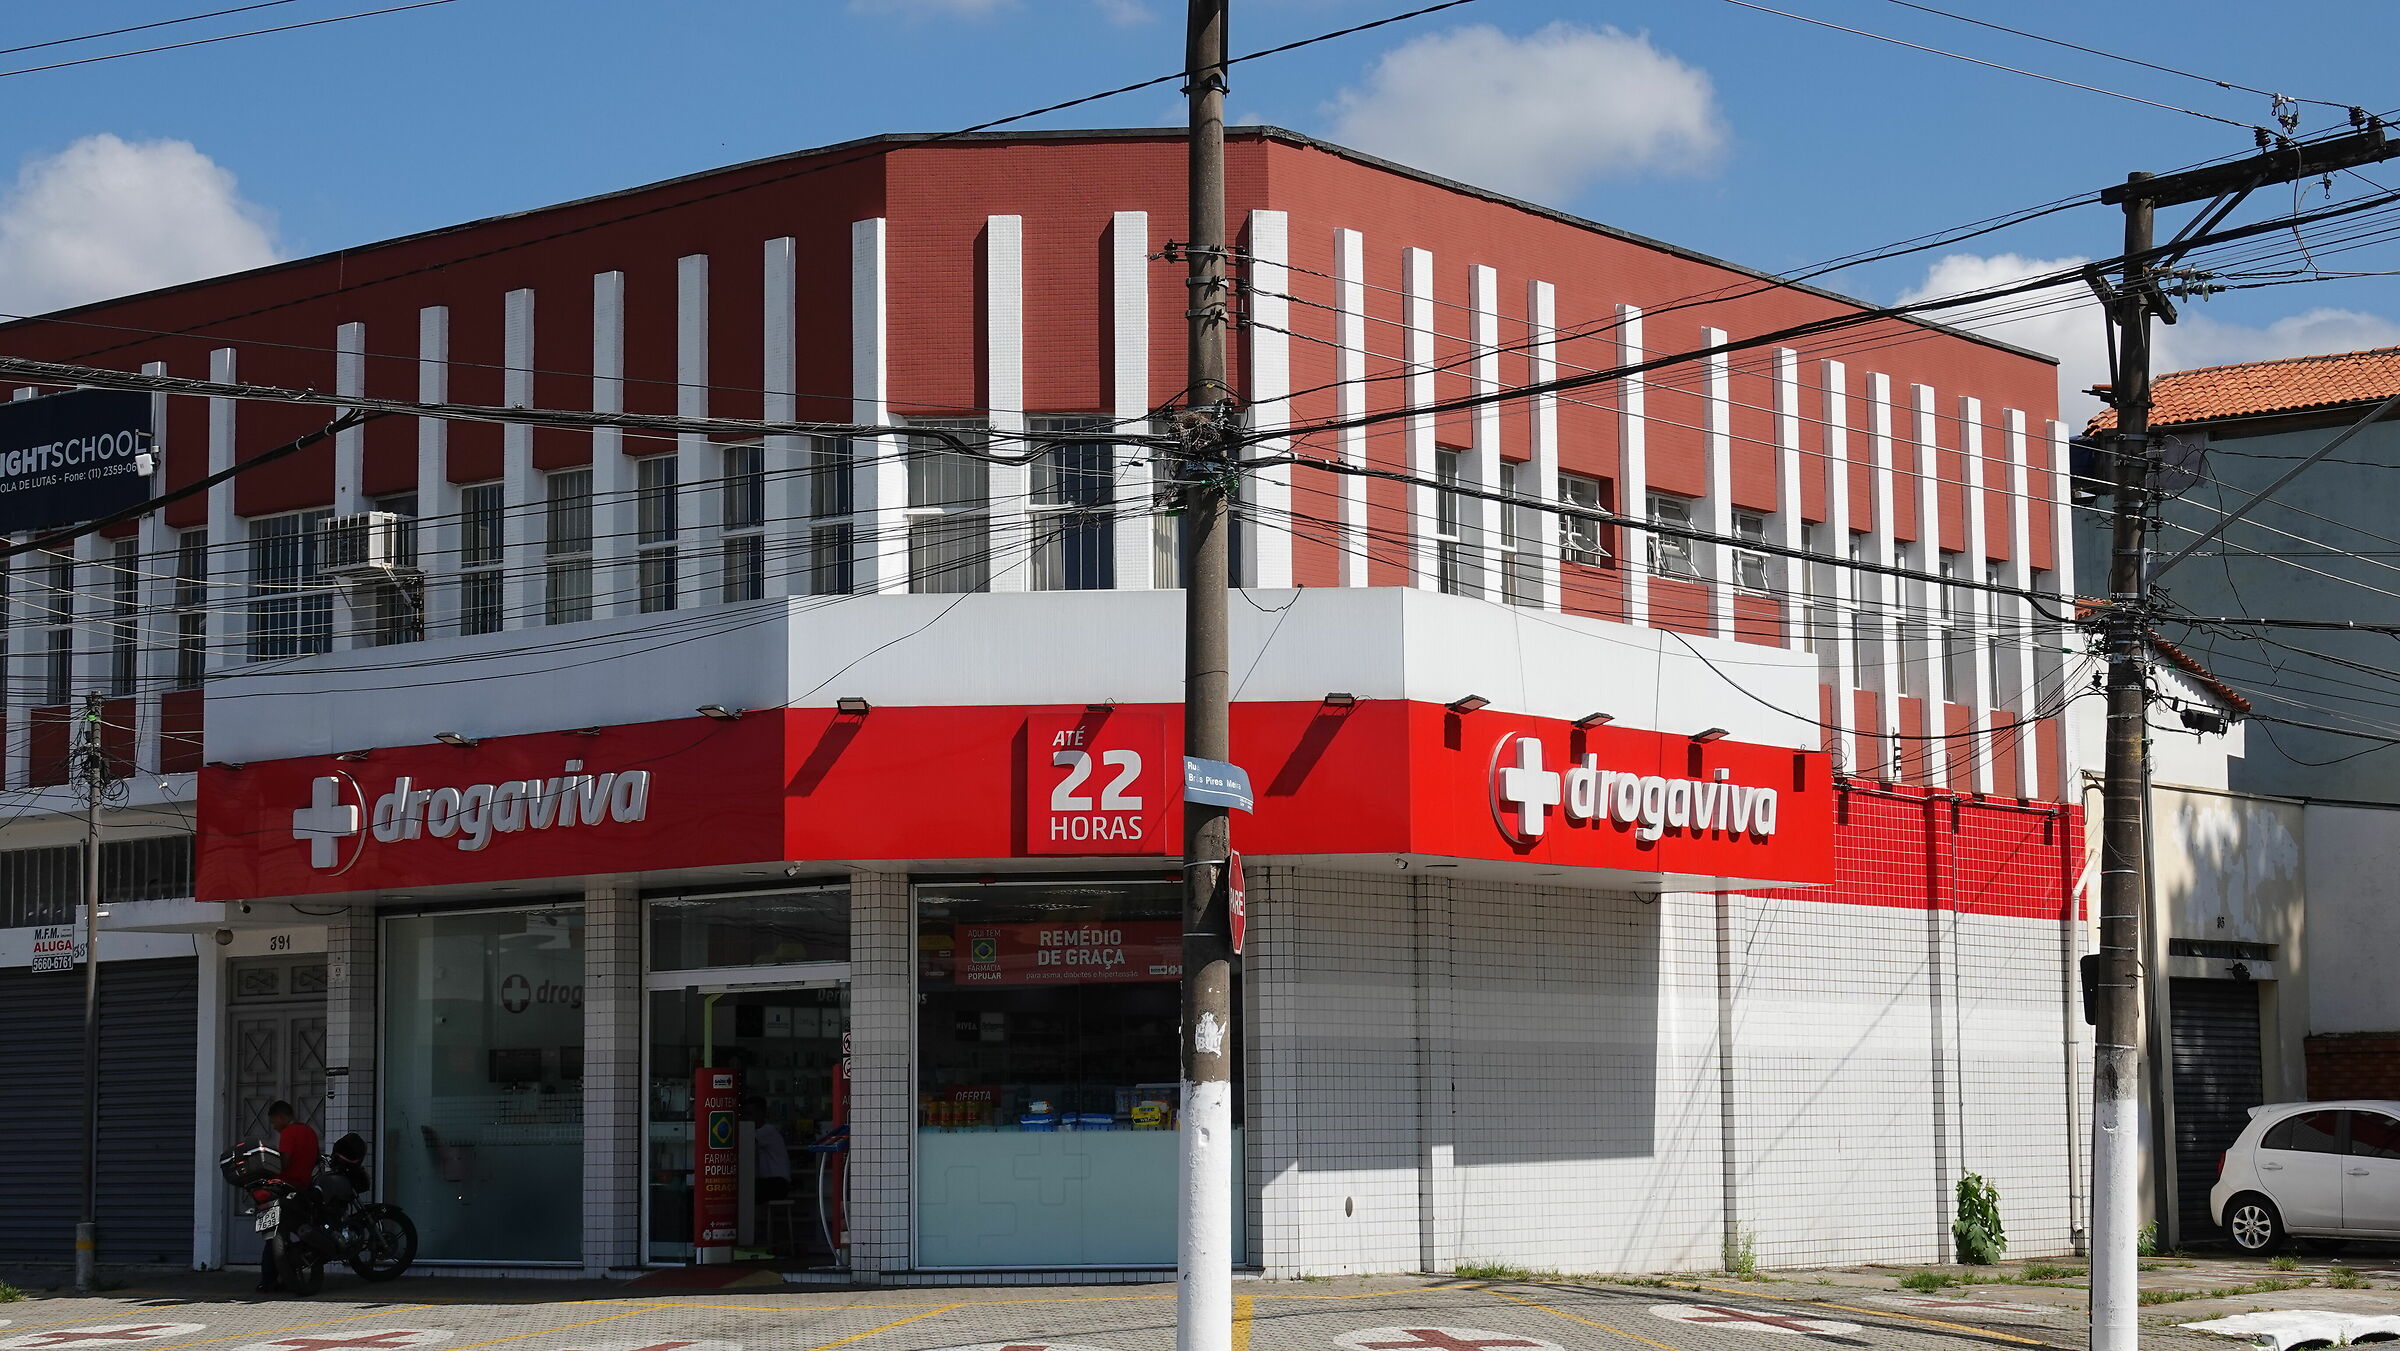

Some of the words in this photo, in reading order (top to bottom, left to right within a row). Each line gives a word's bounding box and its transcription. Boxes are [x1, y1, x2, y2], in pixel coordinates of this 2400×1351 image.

[20, 480, 30, 490] DE
[32, 475, 56, 488] LUTAS
[64, 472, 86, 483] Fone:
[88, 468, 101, 480] (11)
[1052, 726, 1085, 746] ATÉ
[1051, 749, 1142, 811] 22
[1205, 776, 1223, 786] Pires
[372, 759, 650, 851] drogaviva
[1564, 753, 1778, 841] drogaviva
[1051, 816, 1142, 840] HORAS
[34, 927, 60, 940] M.F.M.
[270, 934, 290, 951] 391
[1040, 925, 1122, 946] REMÉDIO
[34, 940, 73, 952] ALUGA
[33, 956, 72, 971] 5660-6761
[1037, 950, 1061, 966] DE
[1065, 948, 1126, 970] GRAÇA
[967, 972, 1002, 980] POPULAR
[955, 1090, 992, 1101] OFERTA
